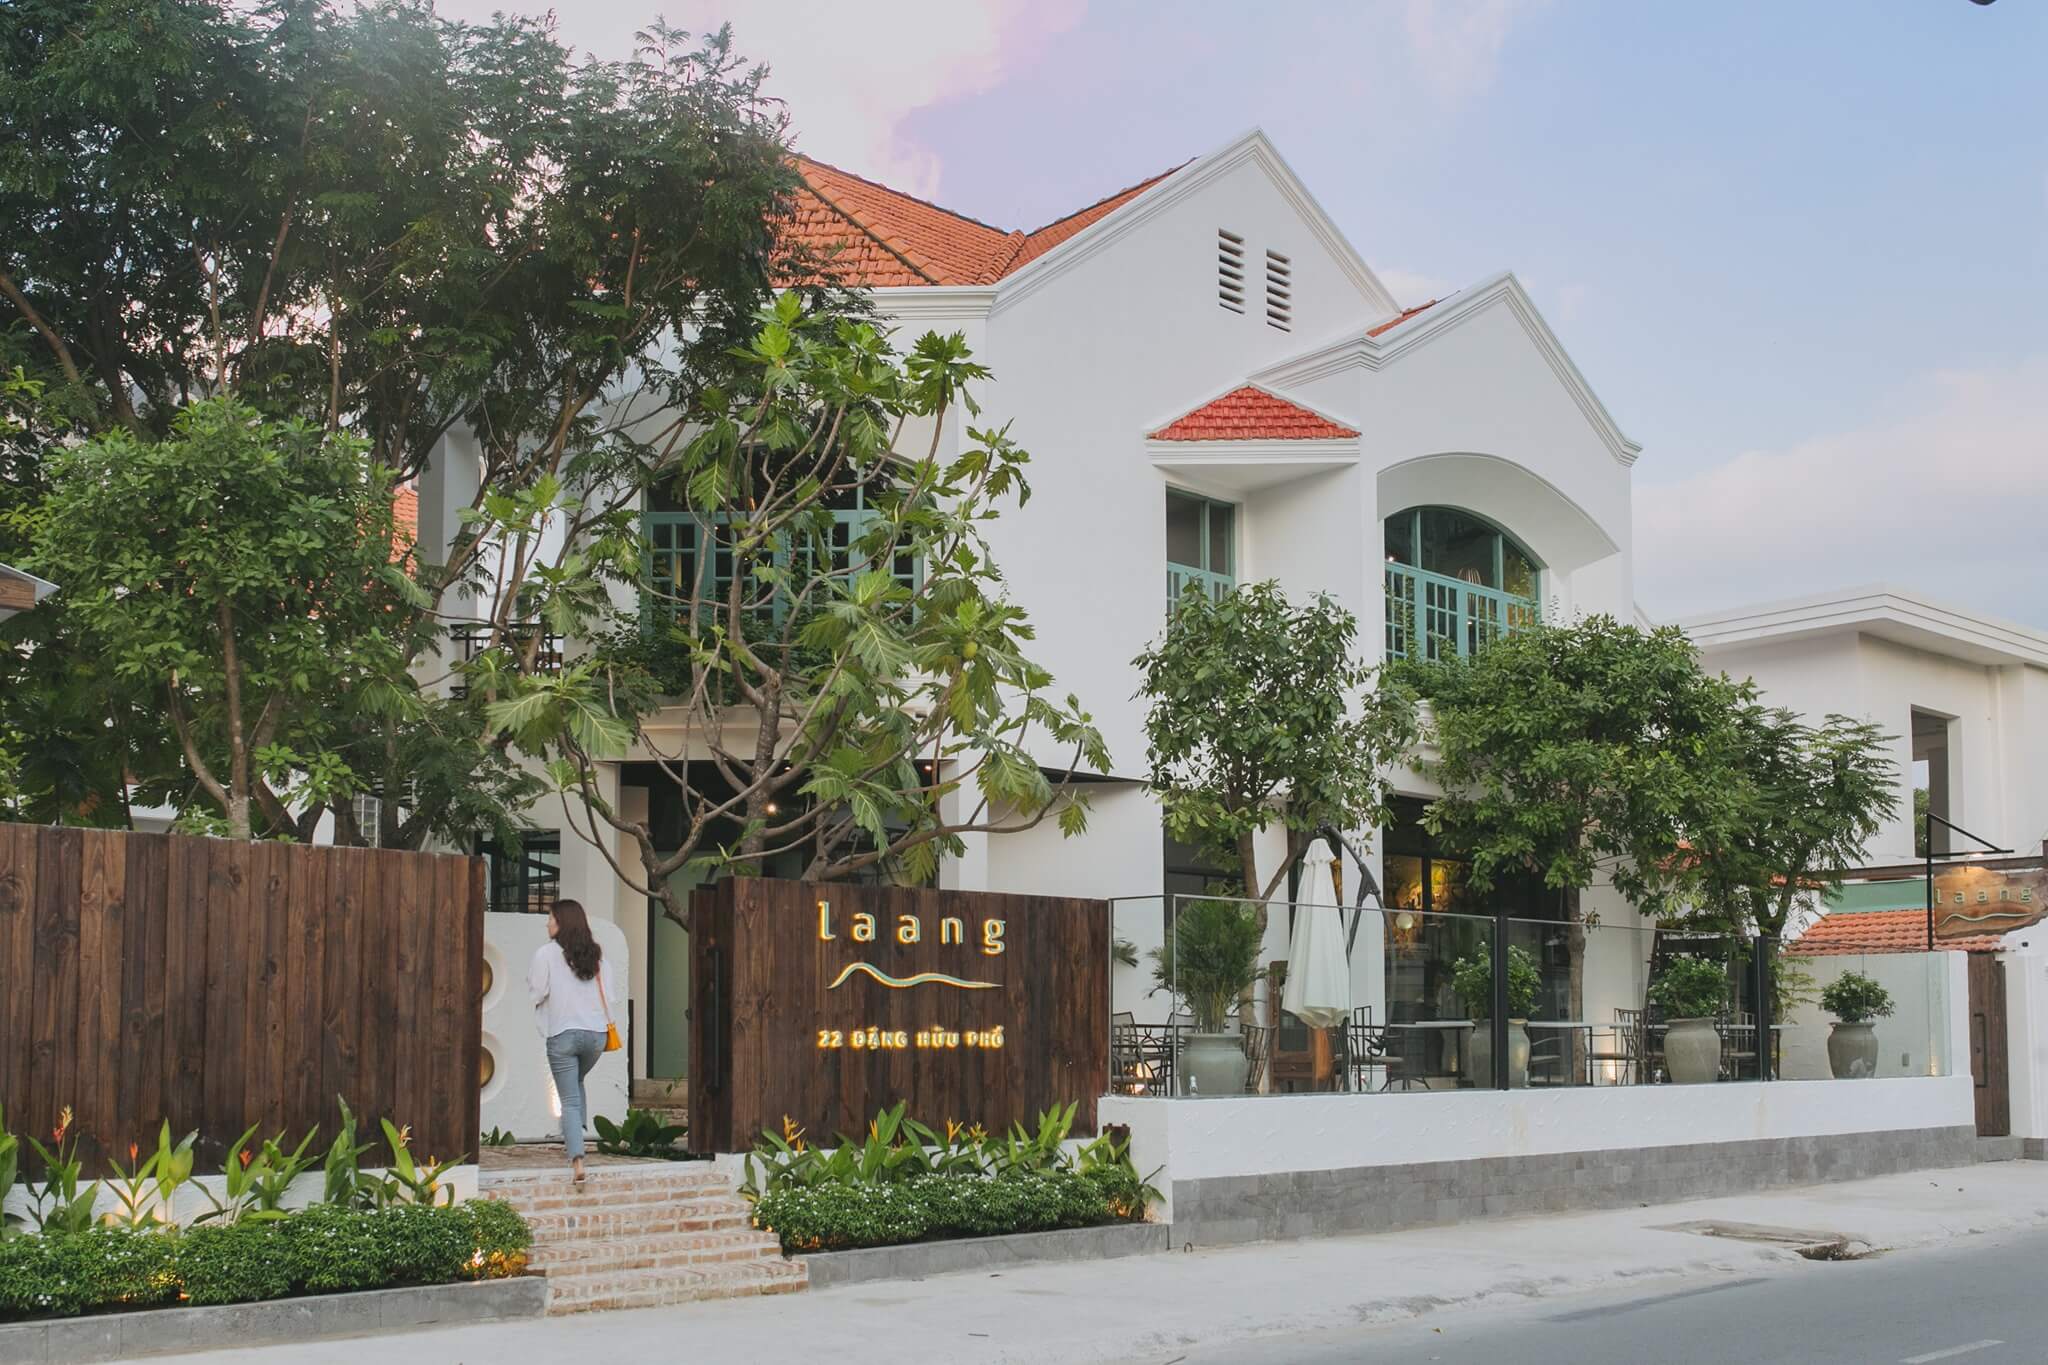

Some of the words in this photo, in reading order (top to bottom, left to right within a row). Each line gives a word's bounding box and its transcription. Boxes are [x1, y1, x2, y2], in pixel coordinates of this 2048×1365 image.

[1936, 887, 2032, 903] laang
[818, 901, 1005, 954] laang
[817, 1030, 843, 1048] 22
